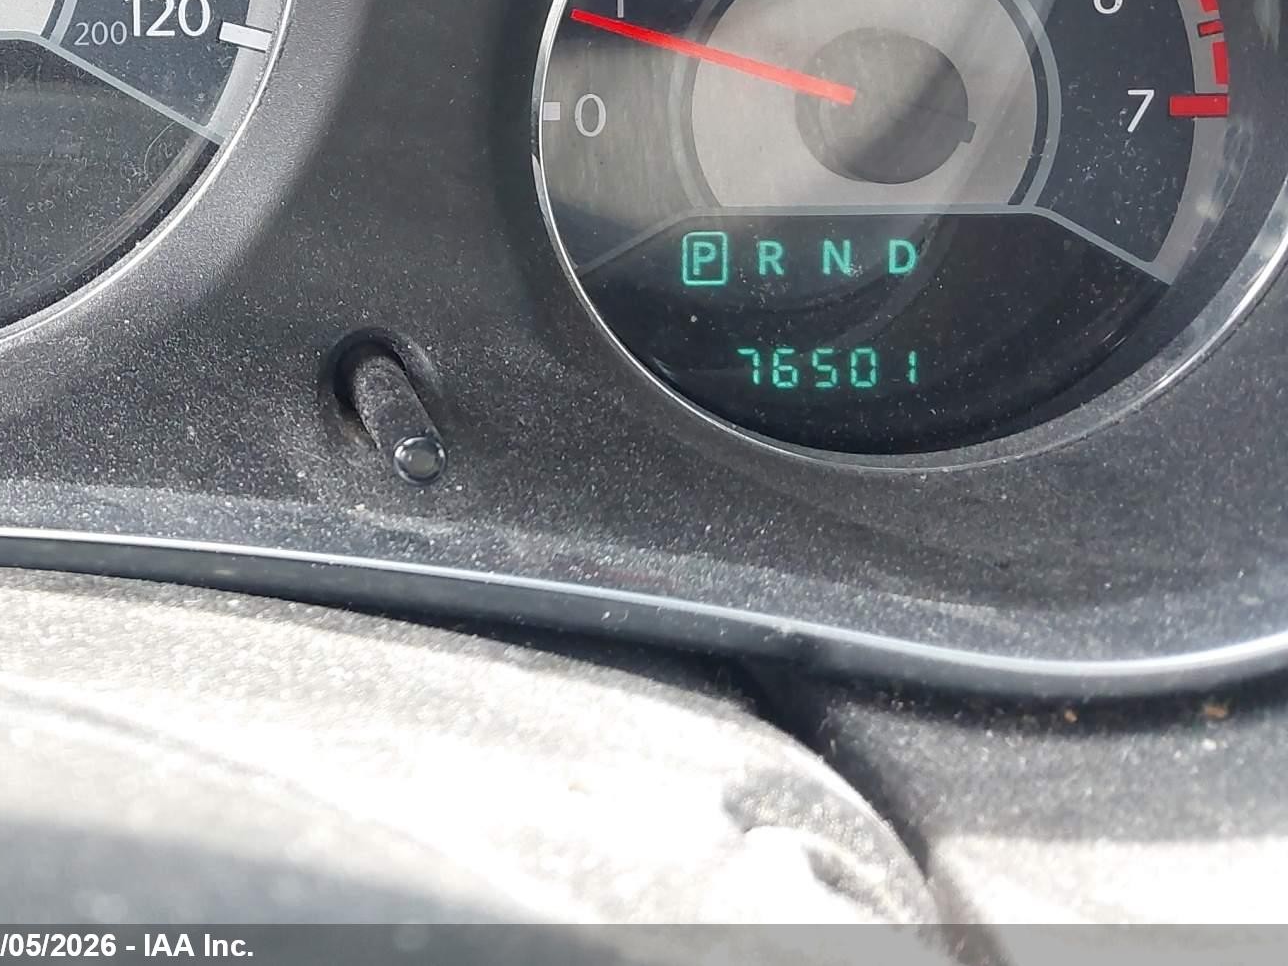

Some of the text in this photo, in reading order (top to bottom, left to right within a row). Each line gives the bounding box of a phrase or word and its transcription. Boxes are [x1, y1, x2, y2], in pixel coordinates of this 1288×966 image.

[75, 21, 127, 45] 200
[575, 94, 606, 137] 0
[1128, 90, 1154, 133] 7
[693, 240, 917, 275] P R N D
[737, 347, 917, 388] 76501
